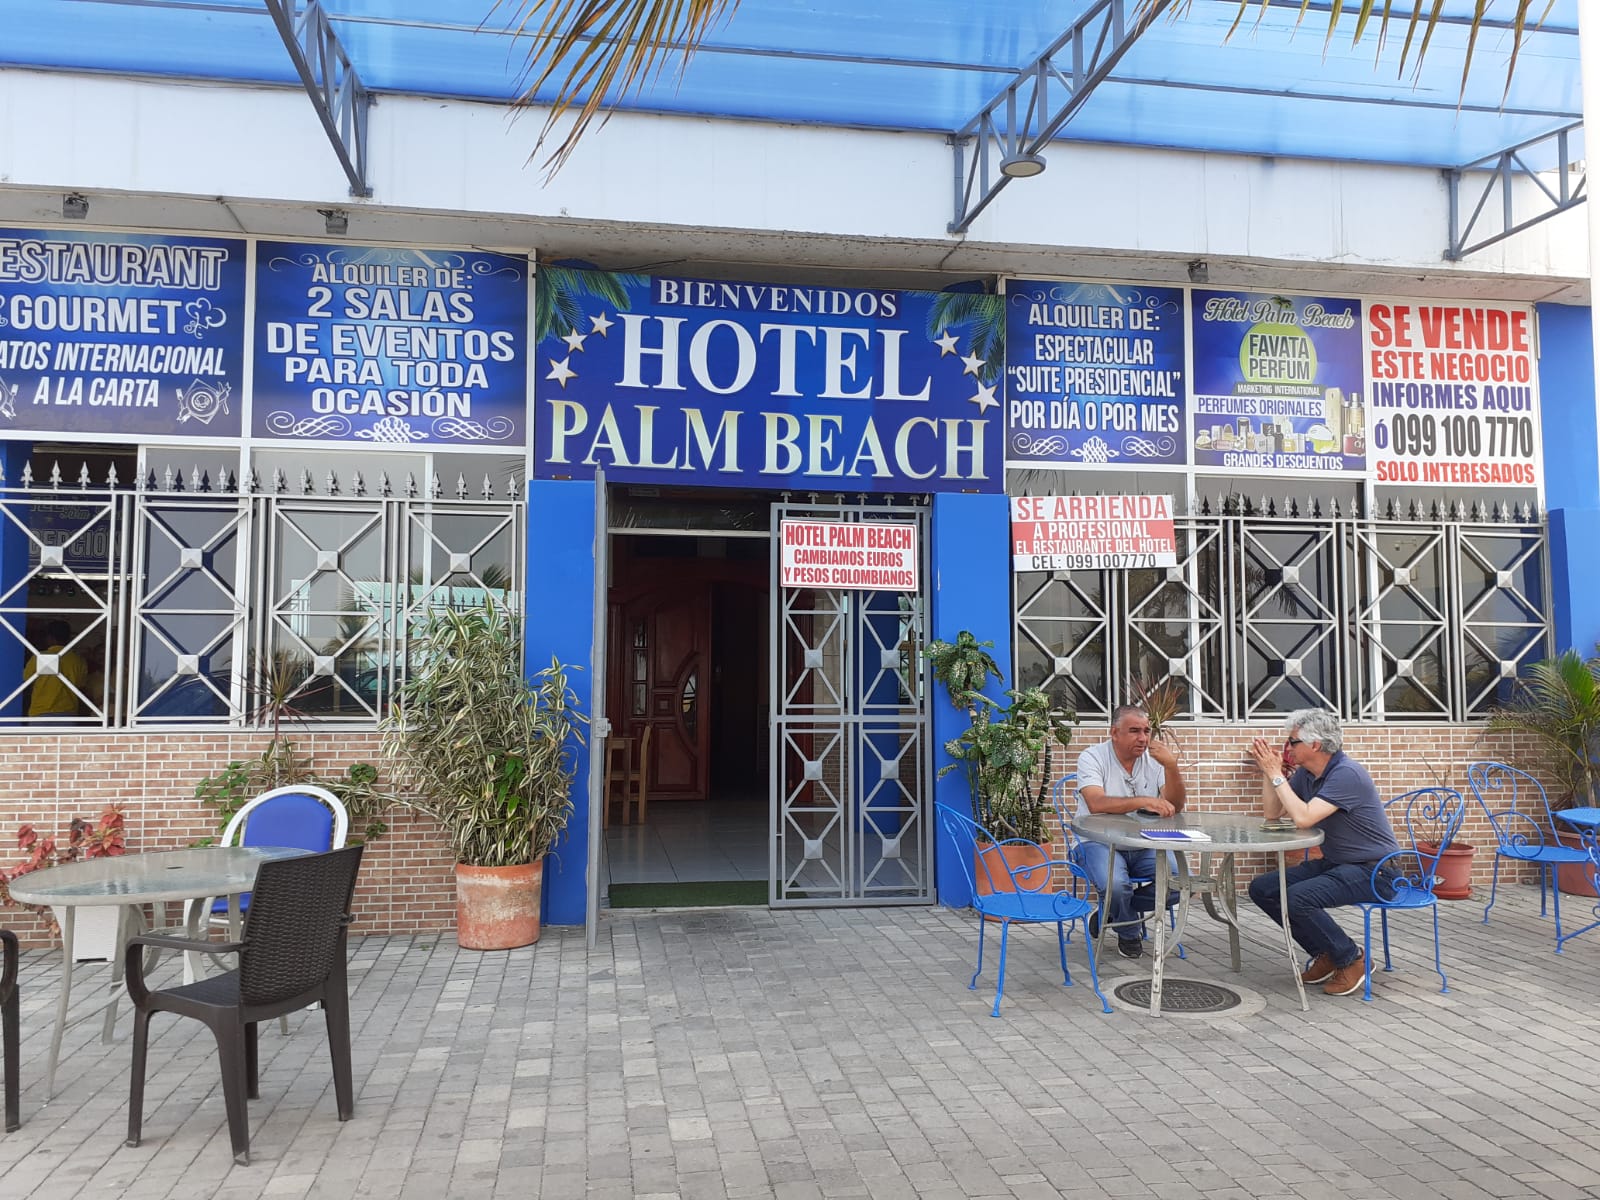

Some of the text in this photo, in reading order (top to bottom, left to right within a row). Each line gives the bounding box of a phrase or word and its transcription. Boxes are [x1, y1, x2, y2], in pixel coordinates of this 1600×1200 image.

[311, 263, 473, 290] ALQUILER DE:
[307, 286, 474, 324] 2 SALAS
[658, 279, 897, 318] BIENVENIDOS
[1203, 297, 1250, 323] Hotel
[1301, 303, 1355, 329] Beach
[10, 295, 182, 334] GOURMET
[1028, 303, 1161, 331] ALQUILER DE:
[1369, 304, 1528, 352] SE VENDE
[267, 322, 515, 362] DE EVENTOS
[614, 313, 932, 402] HOTEL
[1035, 334, 1154, 365] ESPECTACULAR
[1249, 333, 1310, 359] FAVATA
[54, 342, 226, 376] INTERNACIONAL
[285, 357, 489, 389] PARA TODA
[1249, 358, 1311, 381] PERFUM
[1371, 350, 1530, 383] ESTE NEGOCIO
[33, 376, 159, 408] A LA CARTA
[311, 387, 471, 418] OCASIÓN
[1237, 383, 1273, 395] MARKETING
[1372, 382, 1531, 413] INFORMES AQUI
[1010, 396, 1180, 433] POR DÍA O POR MES
[1199, 397, 1322, 417] PERFUMES ORIGINALES
[545, 399, 990, 481] PALM BEACH
[1392, 413, 1437, 457] 099
[1441, 415, 1482, 458] 100
[1485, 416, 1534, 458] 7770
[1223, 452, 1344, 470] GRANDES DESCUENTOS
[1376, 460, 1535, 484] SOLO INTERESADOS
[1017, 496, 1168, 521] SE ARRIENDA
[785, 525, 912, 550] HOTEL PALM BEACH
[1033, 521, 1151, 540] A PROFESIONAL
[793, 549, 904, 568] CAMBIAMOS EUROS
[1016, 538, 1174, 555] EL RESTAURANTE DEL HOTEL
[1032, 553, 1157, 570] CEL: 0991007770
[784, 567, 913, 586] Y PESOS COLOMBIANOS
